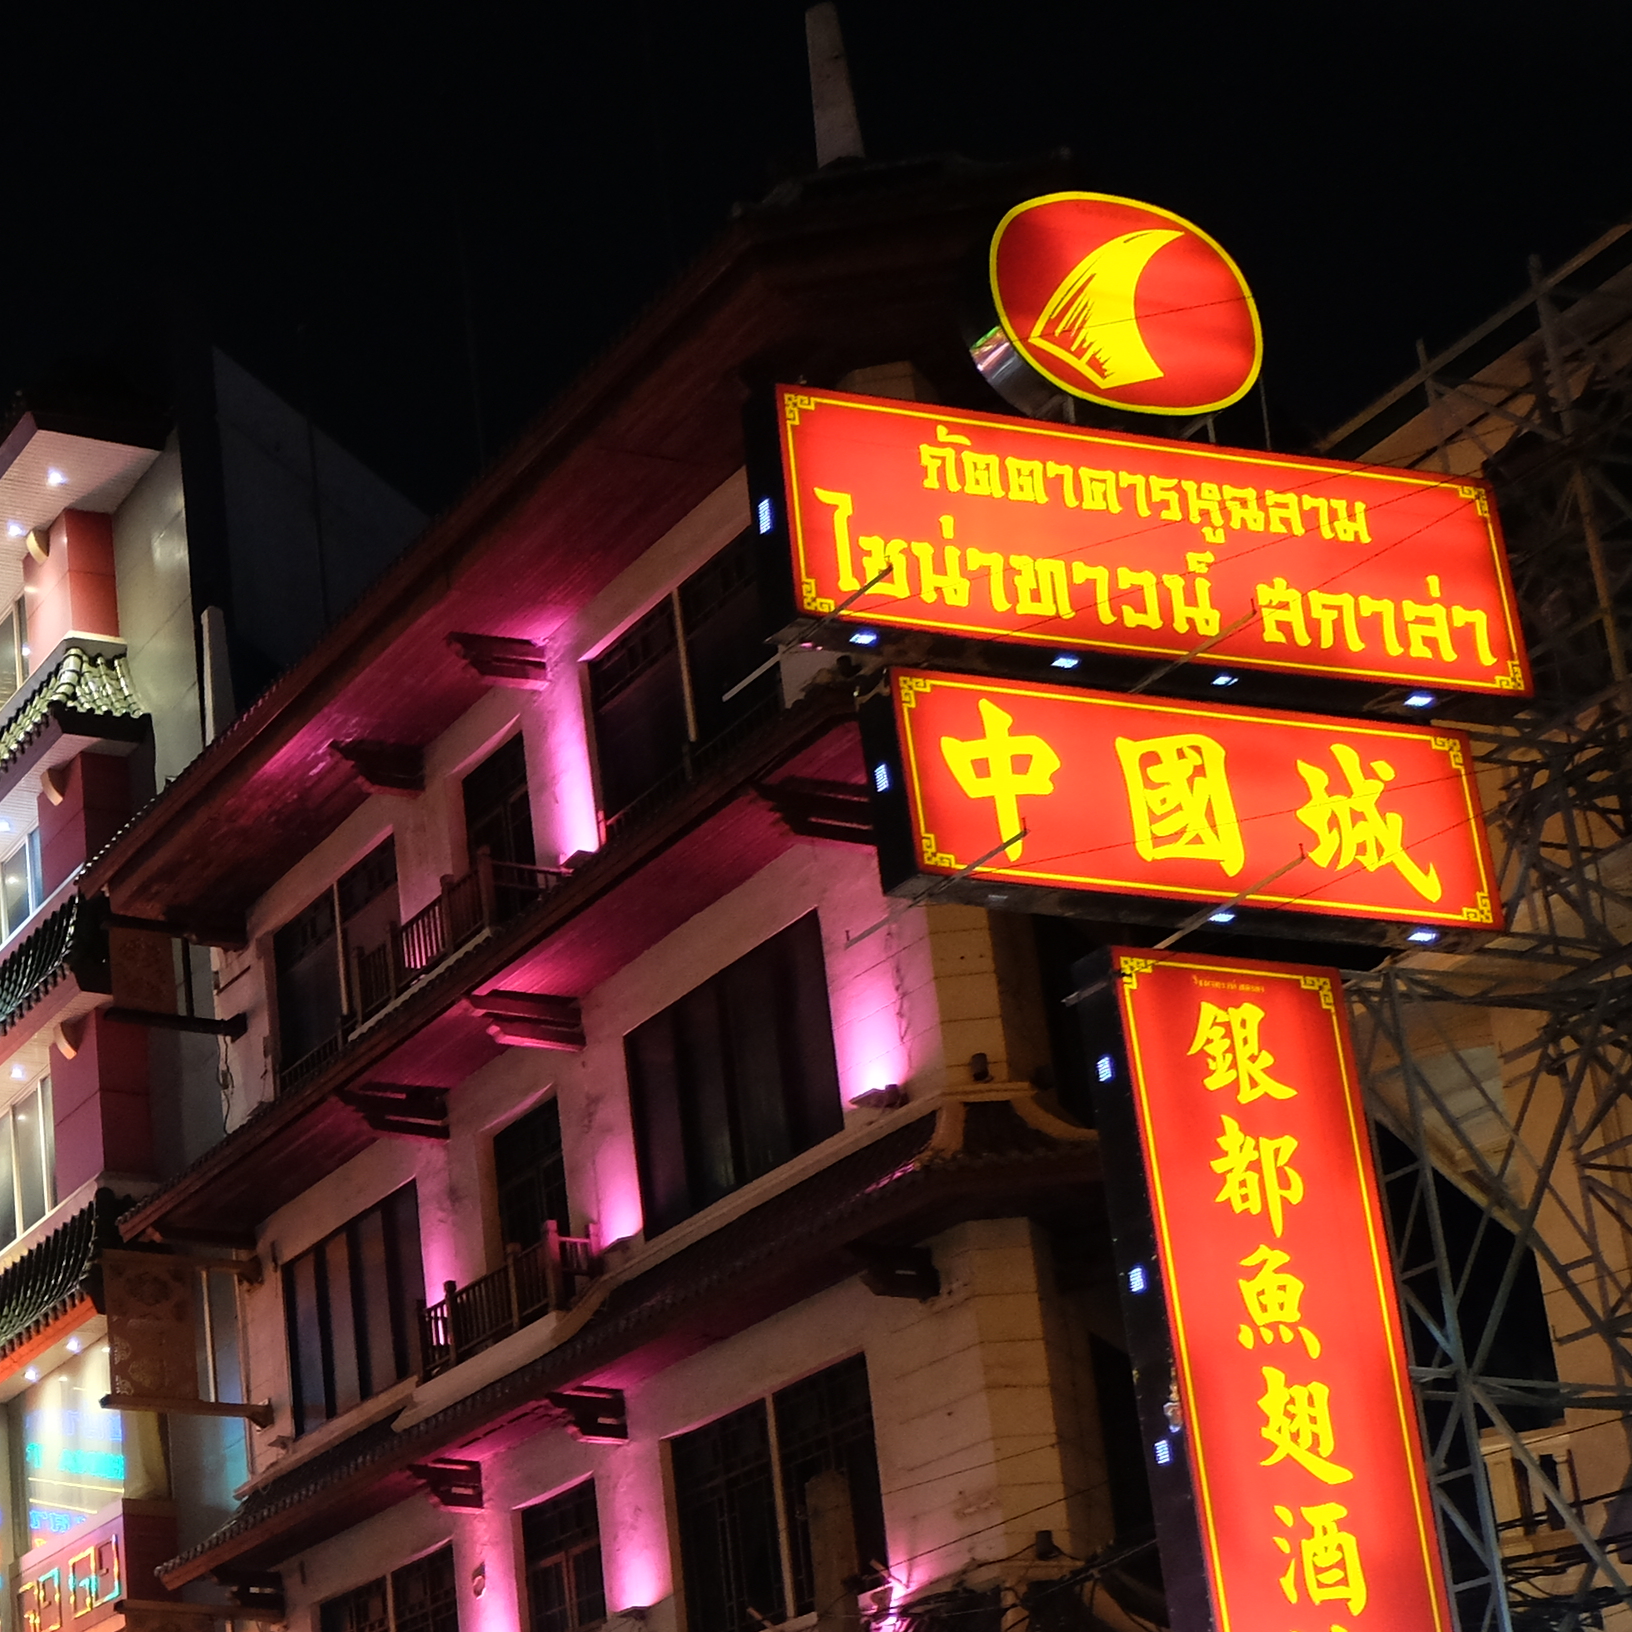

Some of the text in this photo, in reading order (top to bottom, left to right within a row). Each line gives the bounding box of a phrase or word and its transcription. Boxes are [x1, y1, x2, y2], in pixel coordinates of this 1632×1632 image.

[815, 486, 1498, 667] ไชน่าทาวน์ สกาล่า
[941, 698, 1442, 902] 中國城
